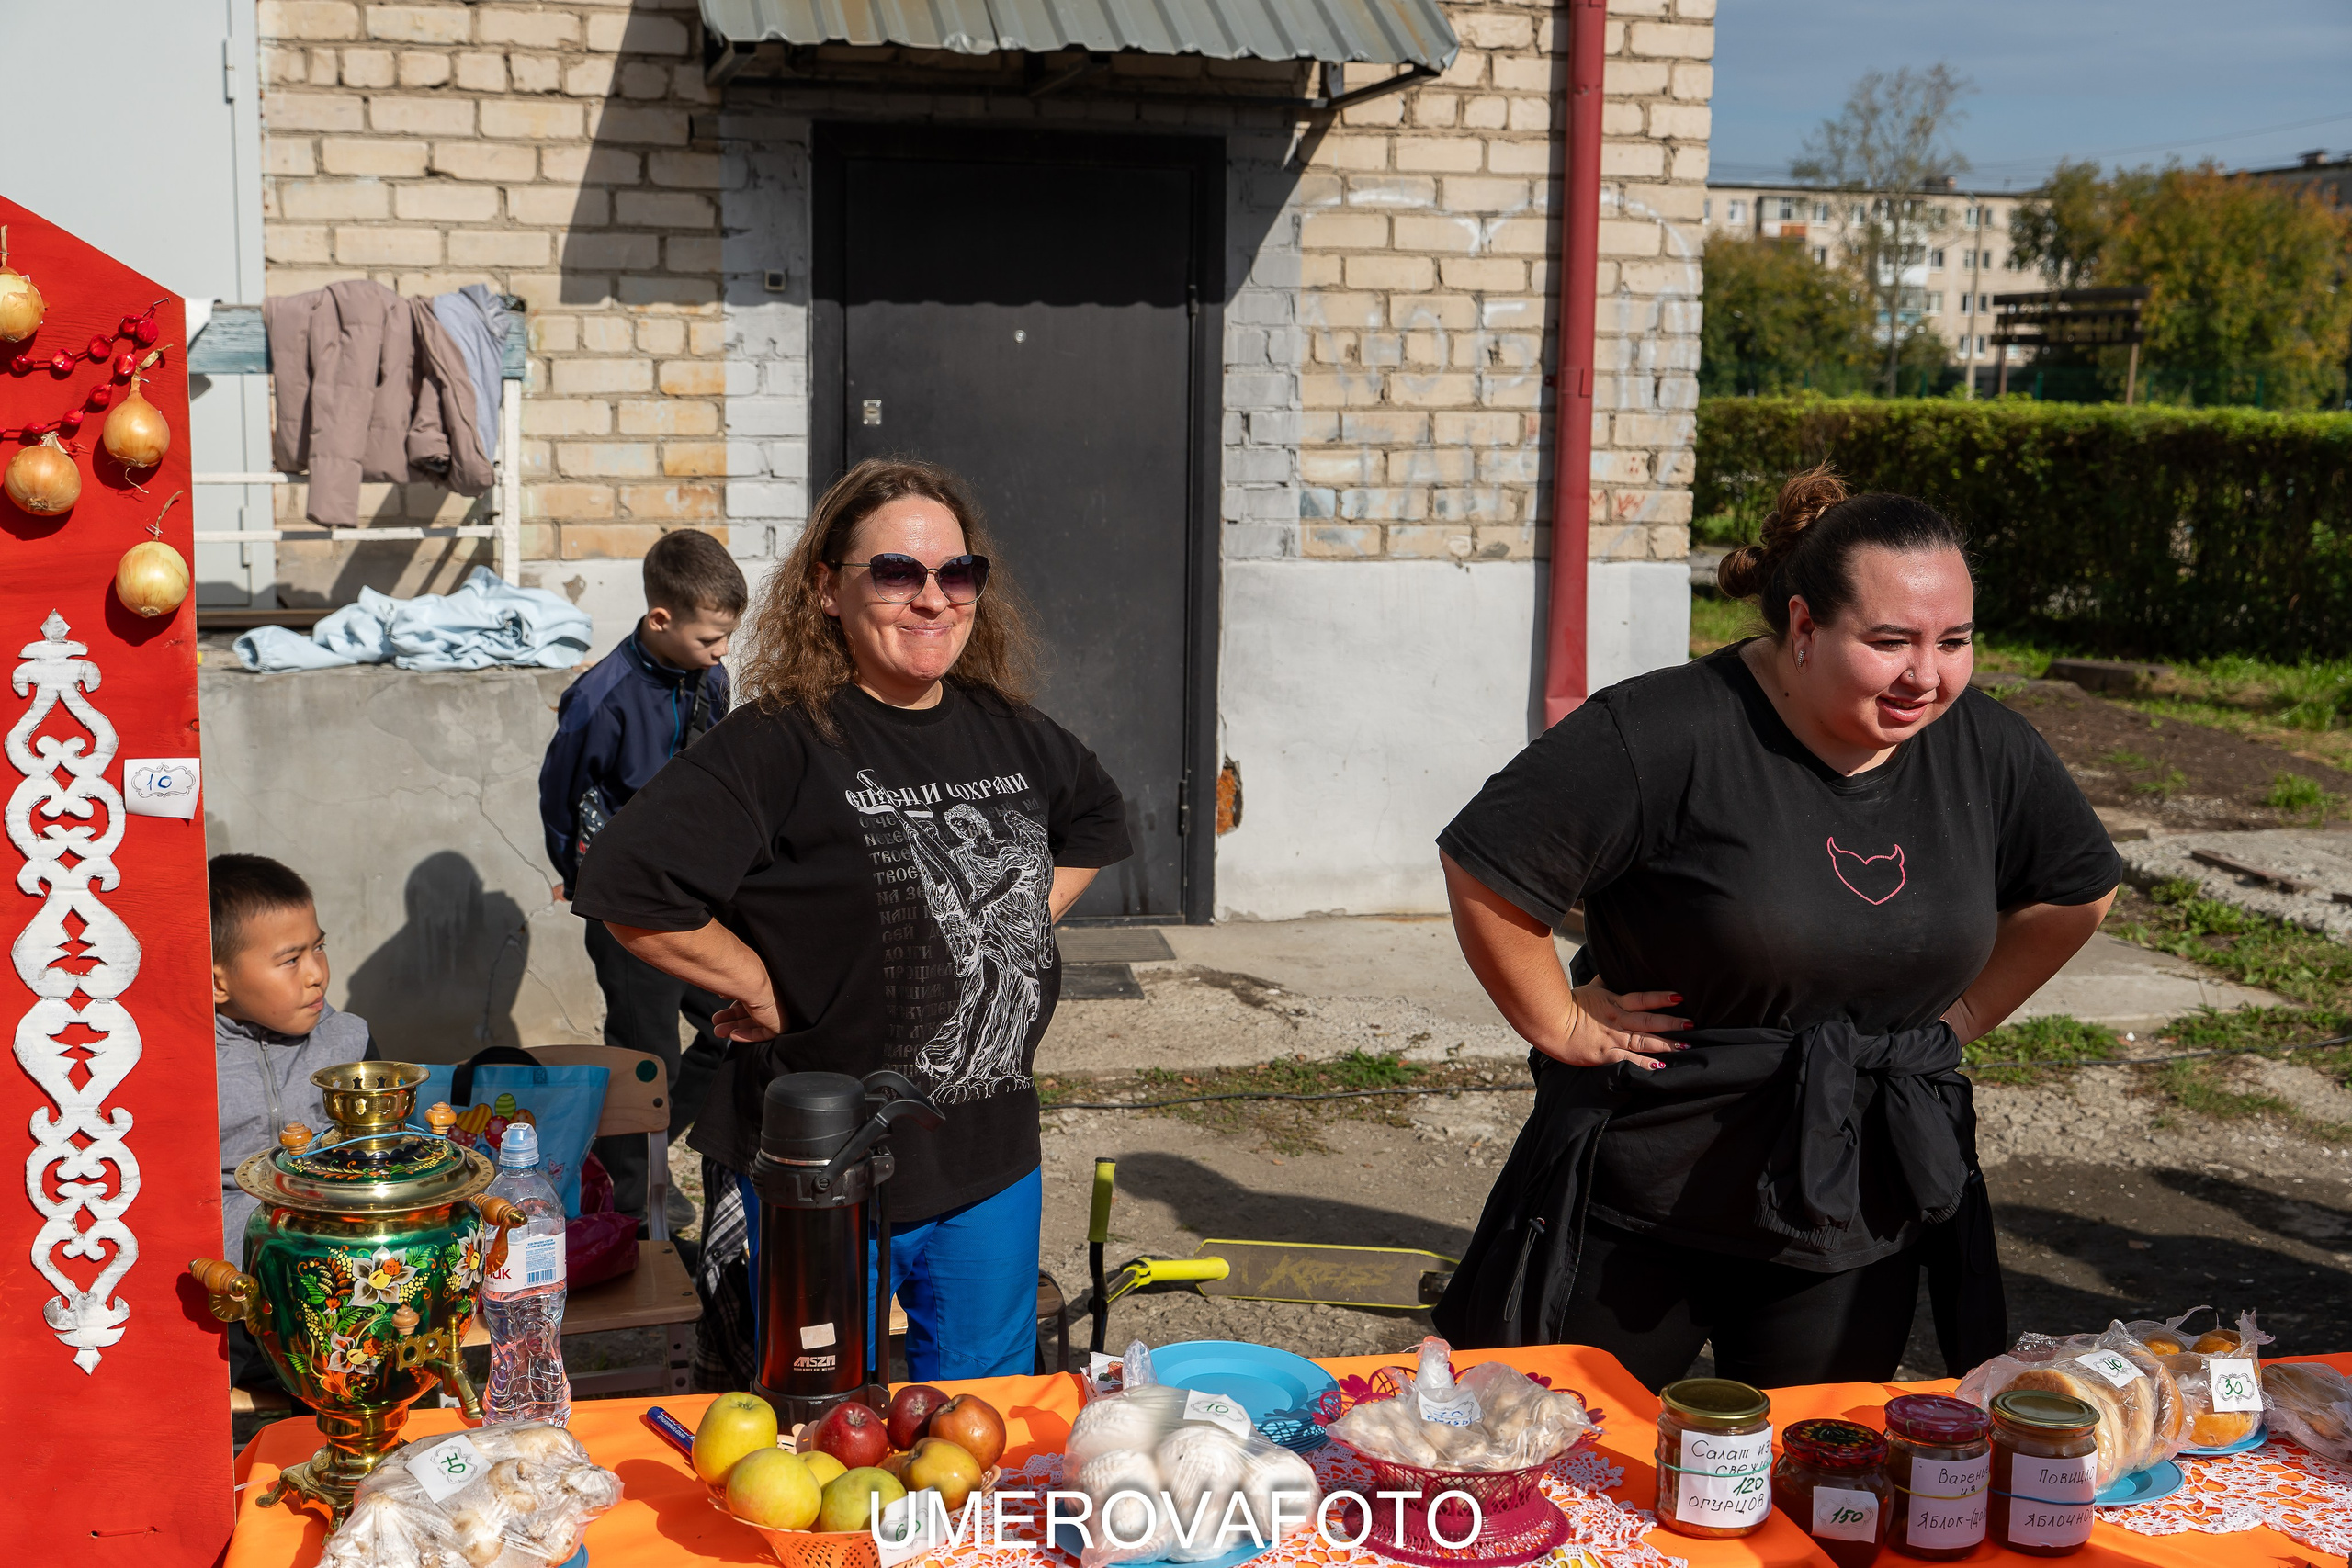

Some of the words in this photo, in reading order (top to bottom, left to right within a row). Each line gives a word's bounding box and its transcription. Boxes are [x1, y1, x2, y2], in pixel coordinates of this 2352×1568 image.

[147, 773, 172, 791] 10
[2224, 1378, 2243, 1395] 30
[1205, 1403, 1229, 1414] 10
[1691, 1439, 1750, 1461] Салат
[1733, 1476, 1764, 1496] 120
[1829, 1506, 1864, 1524] 150
